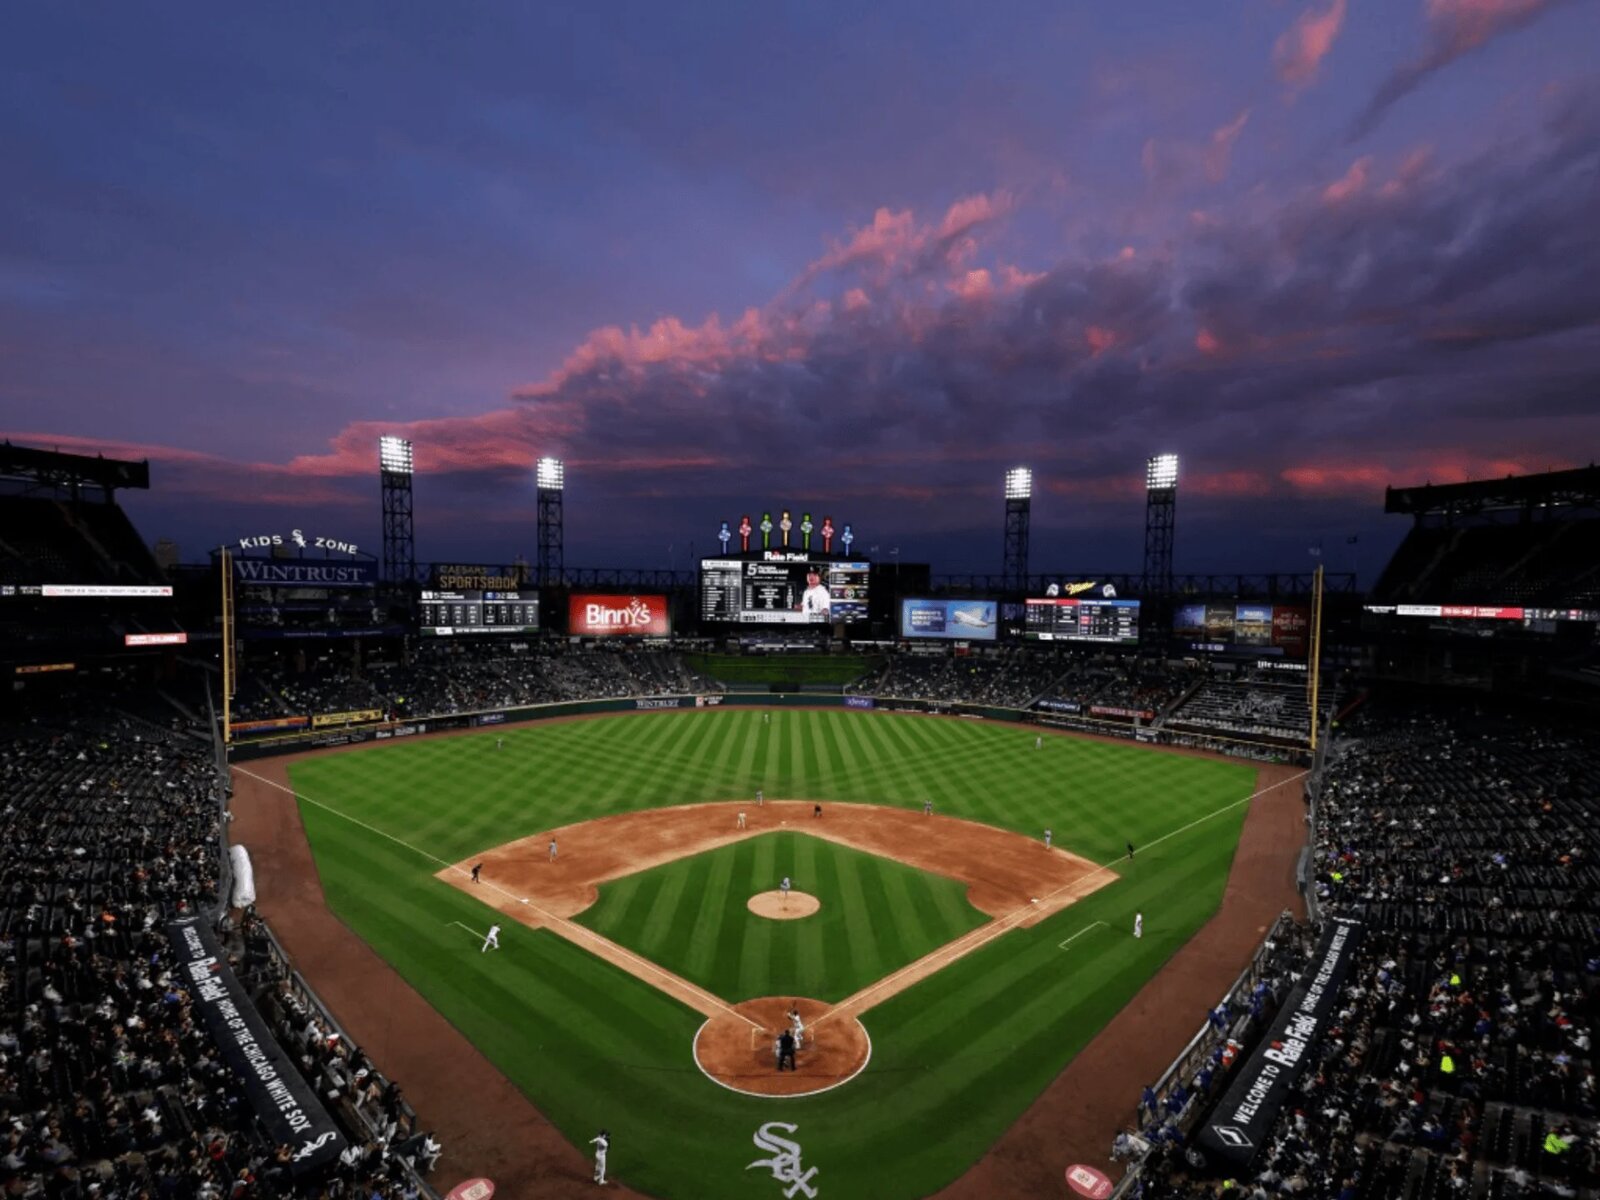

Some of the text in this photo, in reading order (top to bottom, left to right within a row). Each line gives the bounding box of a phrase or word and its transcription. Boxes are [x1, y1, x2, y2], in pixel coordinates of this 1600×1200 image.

[239, 535, 283, 549] KIDS
[315, 537, 358, 554] ZONE
[763, 550, 808, 561] Rate Field
[235, 560, 362, 581] WINTRUST
[747, 563, 758, 575] 5
[440, 575, 518, 589] SPORTSBOOK
[187, 956, 217, 981] Rate
[195, 976, 230, 1002] Field
[228, 1018, 245, 1029] OF
[1284, 1011, 1317, 1042] Field
[233, 1027, 255, 1046] THE
[242, 1043, 277, 1081] CHICAGO
[1263, 1038, 1306, 1068] Rate
[1261, 1064, 1280, 1078] TO
[265, 1078, 298, 1112] WHITE
[1232, 1076, 1274, 1124] WELCOME
[285, 1109, 312, 1134] SOX
